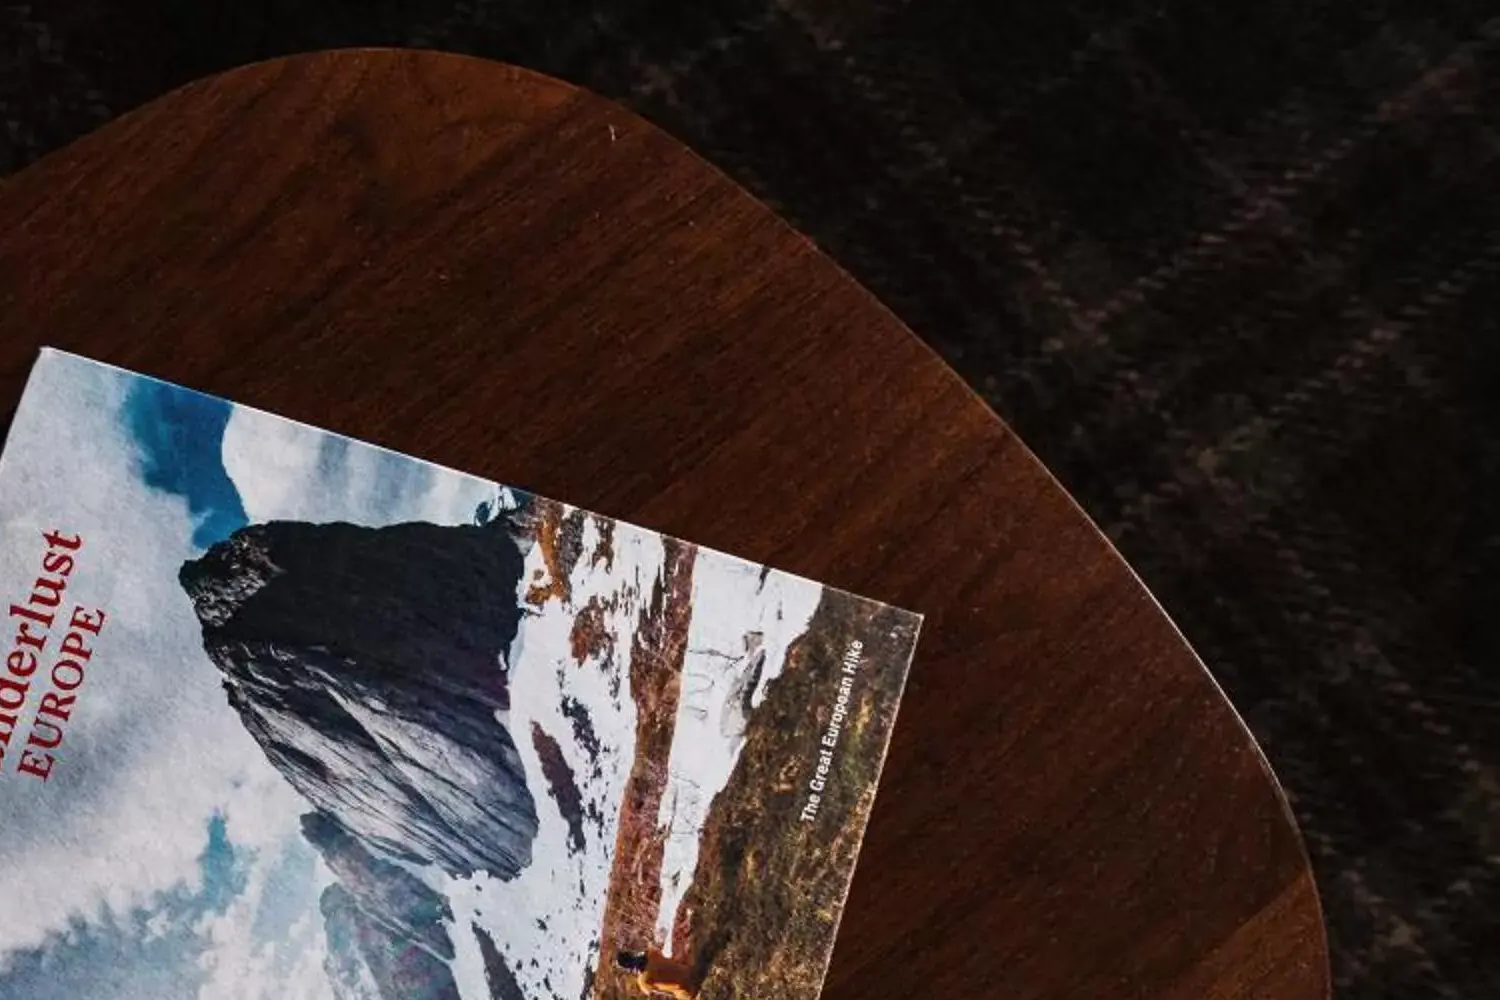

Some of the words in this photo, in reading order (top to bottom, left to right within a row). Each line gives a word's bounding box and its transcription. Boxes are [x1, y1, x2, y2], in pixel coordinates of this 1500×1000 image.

[841, 639, 864, 676] Hike
[18, 605, 106, 783] EUROPE
[821, 676, 853, 748] European
[809, 749, 833, 791] Great
[800, 793, 822, 822] The
